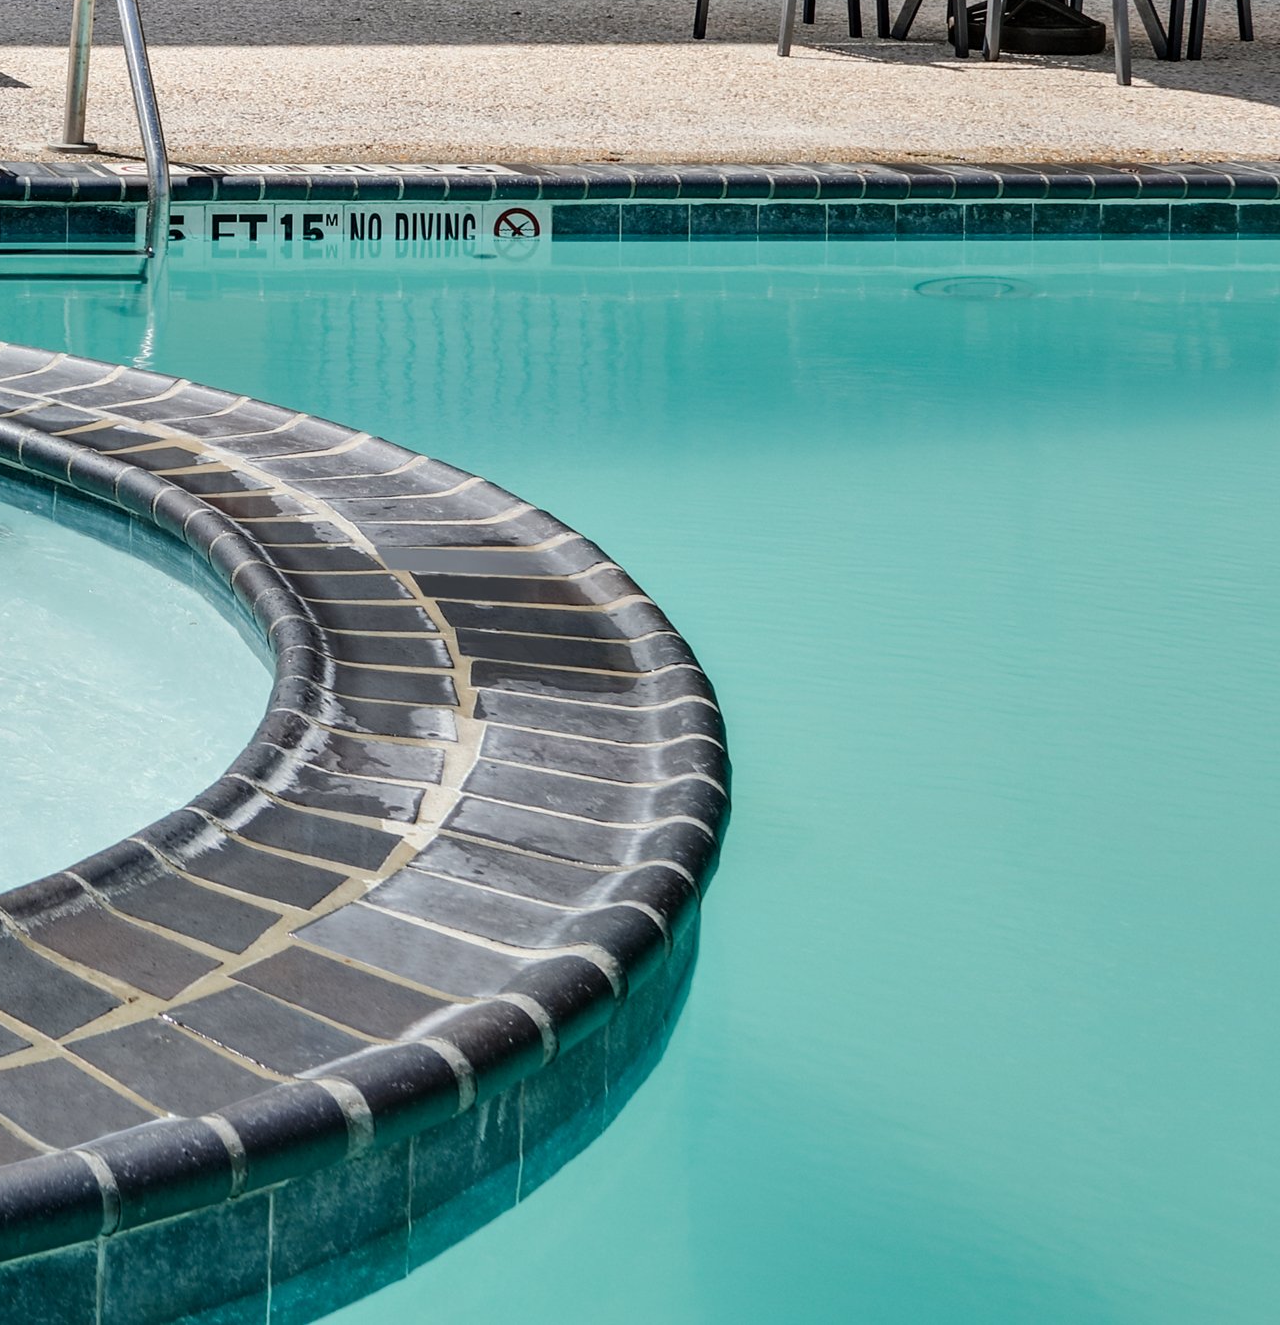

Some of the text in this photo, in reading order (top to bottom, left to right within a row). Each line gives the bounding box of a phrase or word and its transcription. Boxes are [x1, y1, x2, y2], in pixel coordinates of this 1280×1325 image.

[212, 214, 268, 241] FT
[350, 213, 382, 240] NO
[395, 213, 476, 240] DIVING
